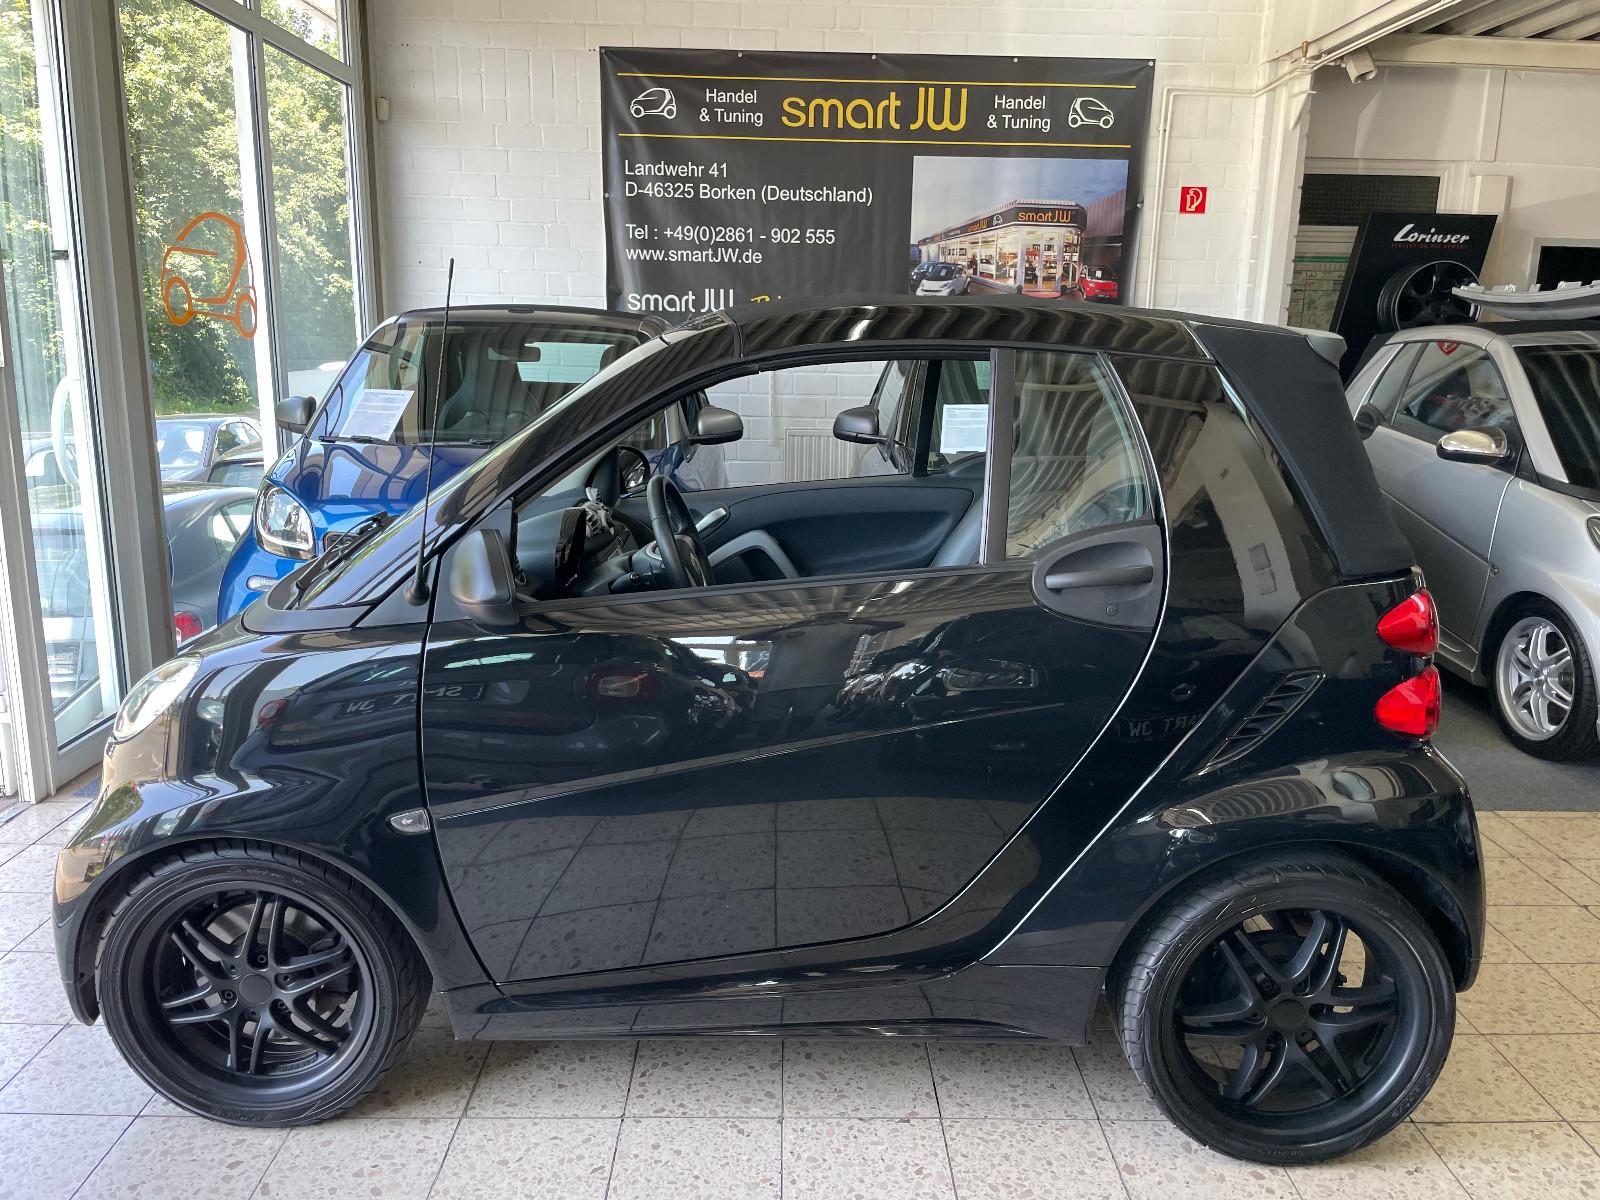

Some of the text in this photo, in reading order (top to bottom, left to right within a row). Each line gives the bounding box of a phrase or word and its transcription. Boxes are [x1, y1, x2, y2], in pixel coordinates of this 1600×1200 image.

[706, 88, 757, 104] Handel
[994, 95, 1046, 110] Handel
[699, 108, 763, 126] & Tuning
[781, 87, 968, 131] smart JW
[986, 114, 1051, 133] & Tuning
[625, 159, 727, 178] Landwehr 41
[625, 182, 873, 206] D-46325 Borken (Deutschland)
[625, 223, 648, 239] Tel
[663, 225, 753, 245] +49(0)2861
[771, 228, 800, 243] 902
[805, 229, 835, 244] 555
[1393, 223, 1470, 244] Lorinser
[626, 247, 762, 264] www.smartJW.de
[627, 290, 696, 313] smart
